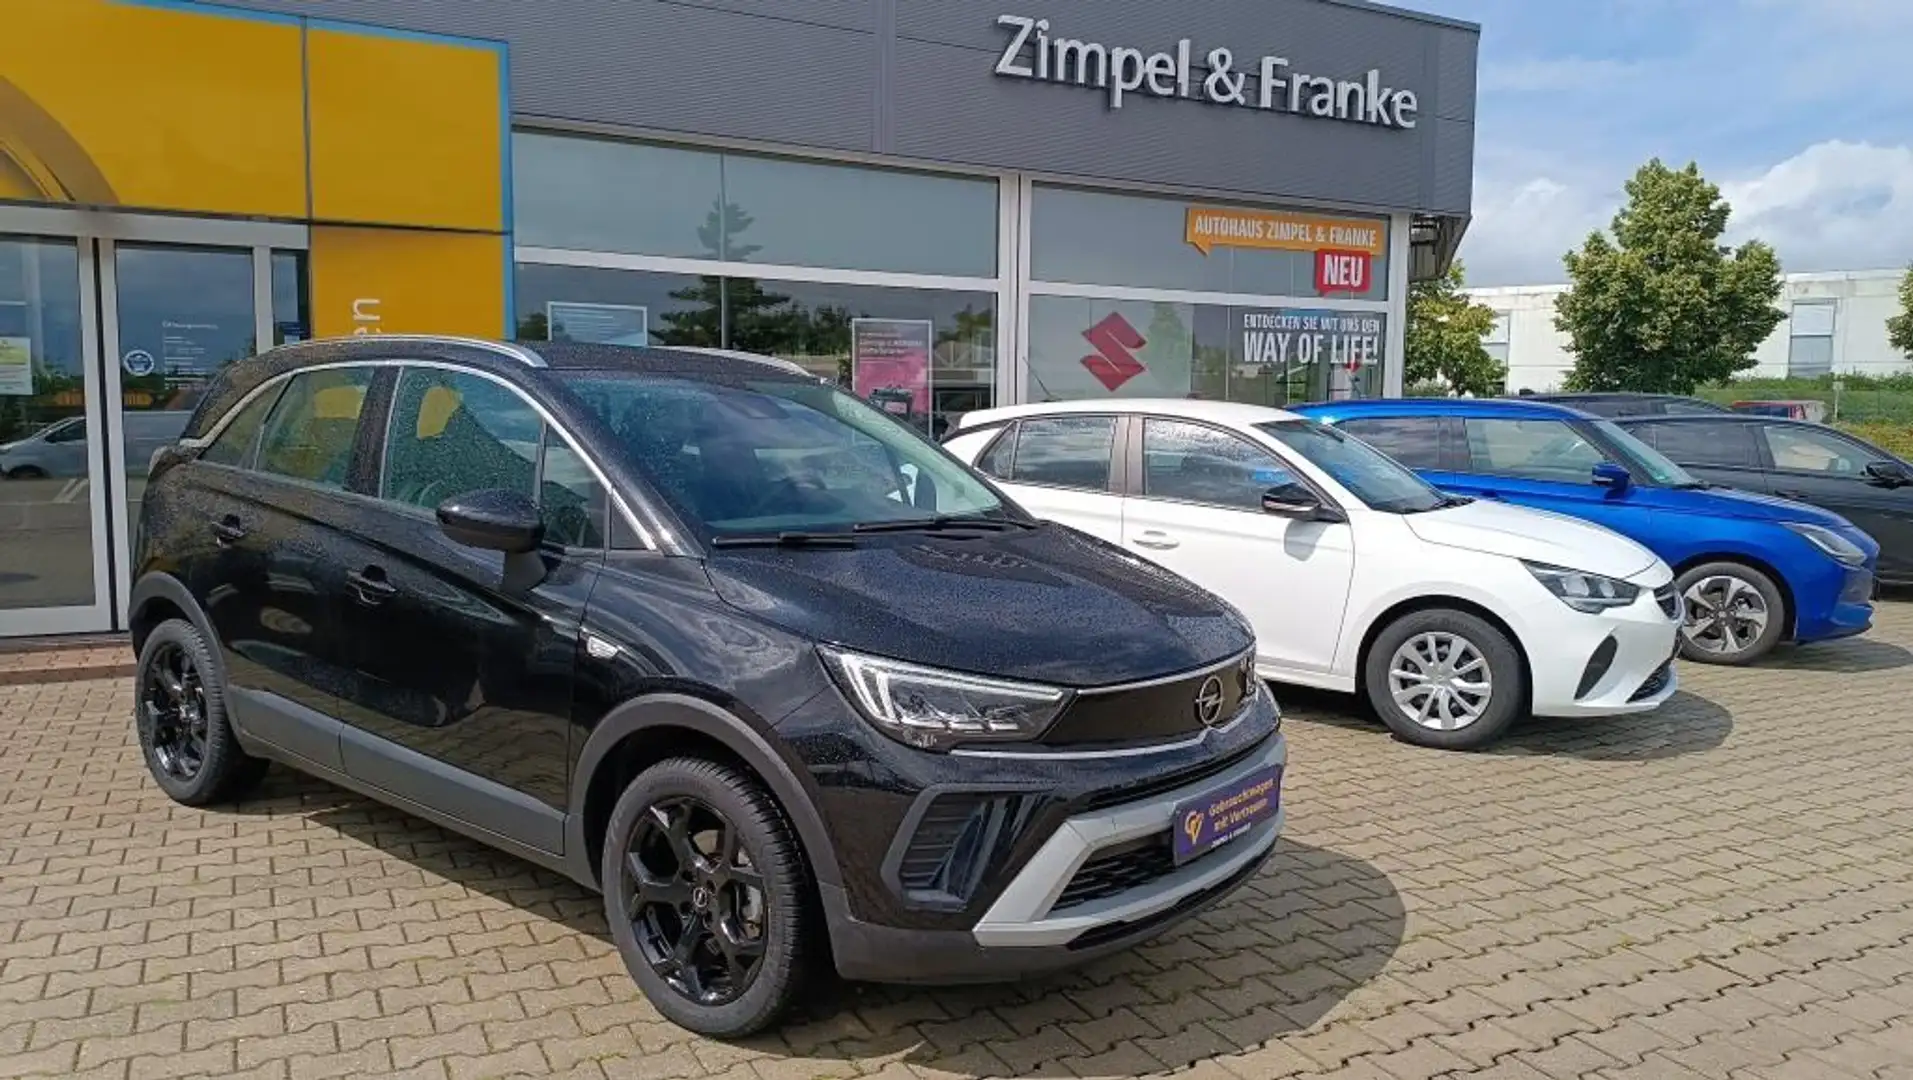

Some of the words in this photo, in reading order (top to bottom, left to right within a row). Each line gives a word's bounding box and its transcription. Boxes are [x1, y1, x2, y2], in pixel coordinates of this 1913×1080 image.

[995, 14, 1191, 109] Zimpel
[1204, 47, 1246, 105] &
[1259, 55, 1418, 129] Franke
[1195, 215, 1263, 240] AUTOHAUS
[1267, 219, 1312, 243] ZIMPEL
[1316, 227, 1325, 243] &
[1330, 227, 1376, 248] FRANKE
[1323, 254, 1363, 287] NEU
[1243, 313, 1300, 330] ENTDECKEN
[1303, 316, 1318, 331] SIE
[1244, 331, 1290, 362] WAY
[1298, 333, 1324, 363] OF
[1330, 334, 1379, 364] LIFE!
